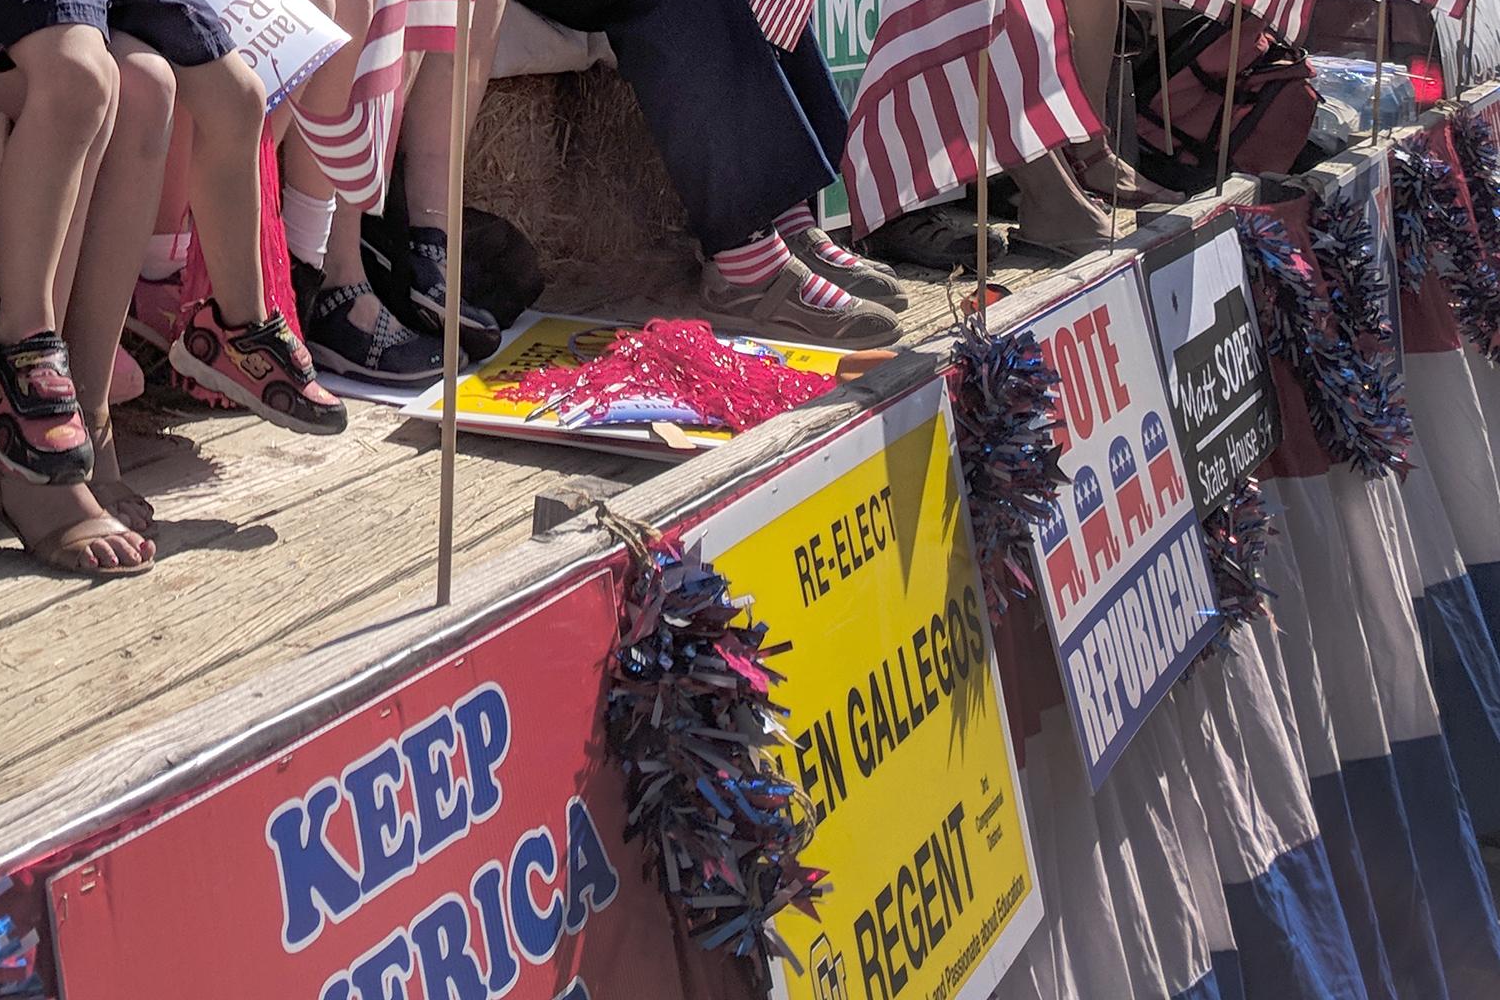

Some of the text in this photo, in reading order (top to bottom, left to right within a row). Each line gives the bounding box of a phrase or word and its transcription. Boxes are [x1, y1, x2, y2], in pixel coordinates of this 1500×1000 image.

[1179, 321, 1264, 433] Matt SOPER
[1197, 407, 1274, 506] State House 54
[794, 485, 896, 608] RE-ELECT
[847, 585, 984, 778] GALLEGOS
[1066, 523, 1216, 768] REPUBLICAN
[266, 681, 511, 952] KEEP
[318, 796, 619, 1000] ERICA
[854, 800, 974, 1000] REGENT
[945, 932, 981, 993] Passionate
[980, 919, 999, 946] about
[996, 874, 1025, 924] Education
